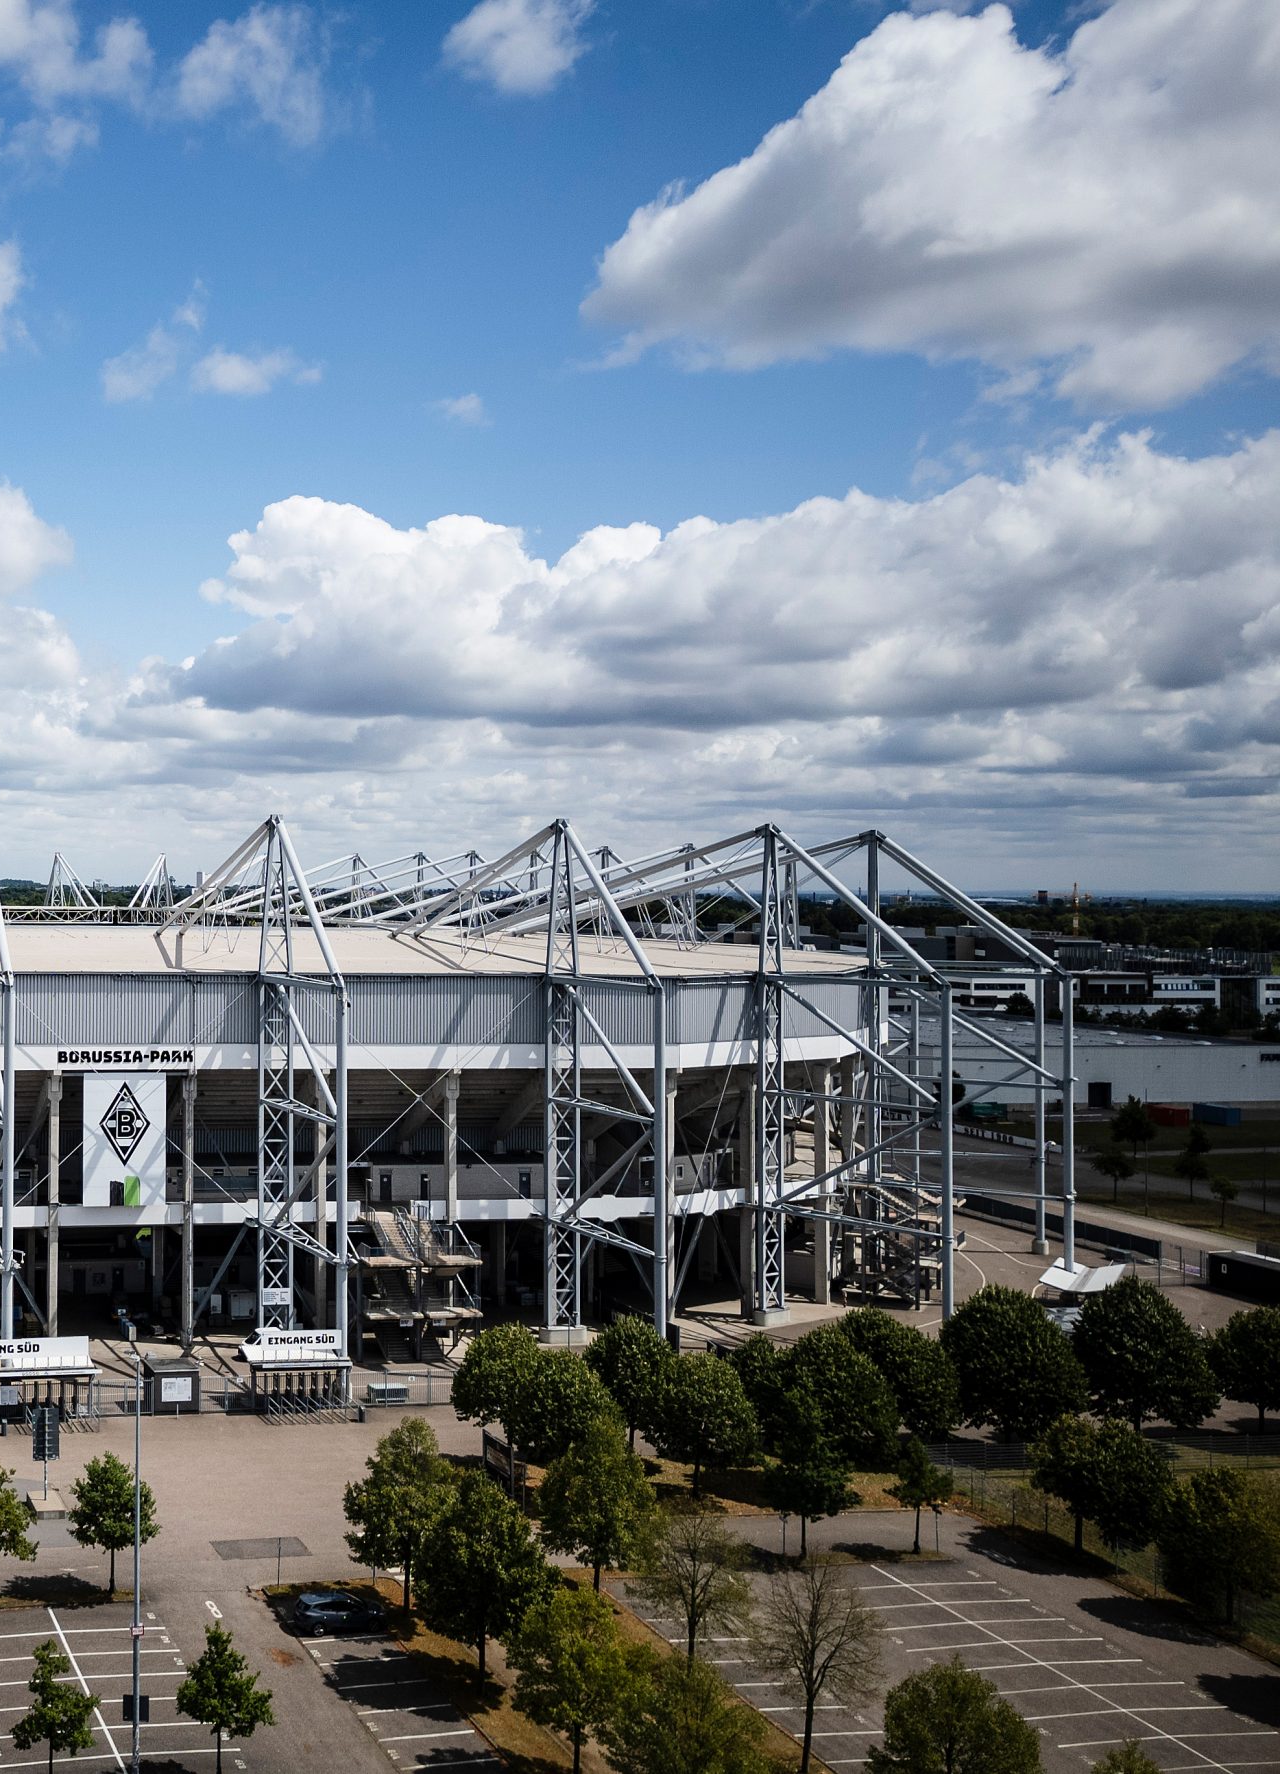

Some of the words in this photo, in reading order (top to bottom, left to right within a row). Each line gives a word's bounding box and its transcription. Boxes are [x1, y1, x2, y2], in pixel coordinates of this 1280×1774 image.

[57, 1050, 194, 1064] BORUSSIA-PARK
[268, 1336, 313, 1345] EINGANG
[315, 1334, 335, 1344] SÜD
[16, 1341, 40, 1353] SÜD
[205, 1600, 223, 1618] 8
